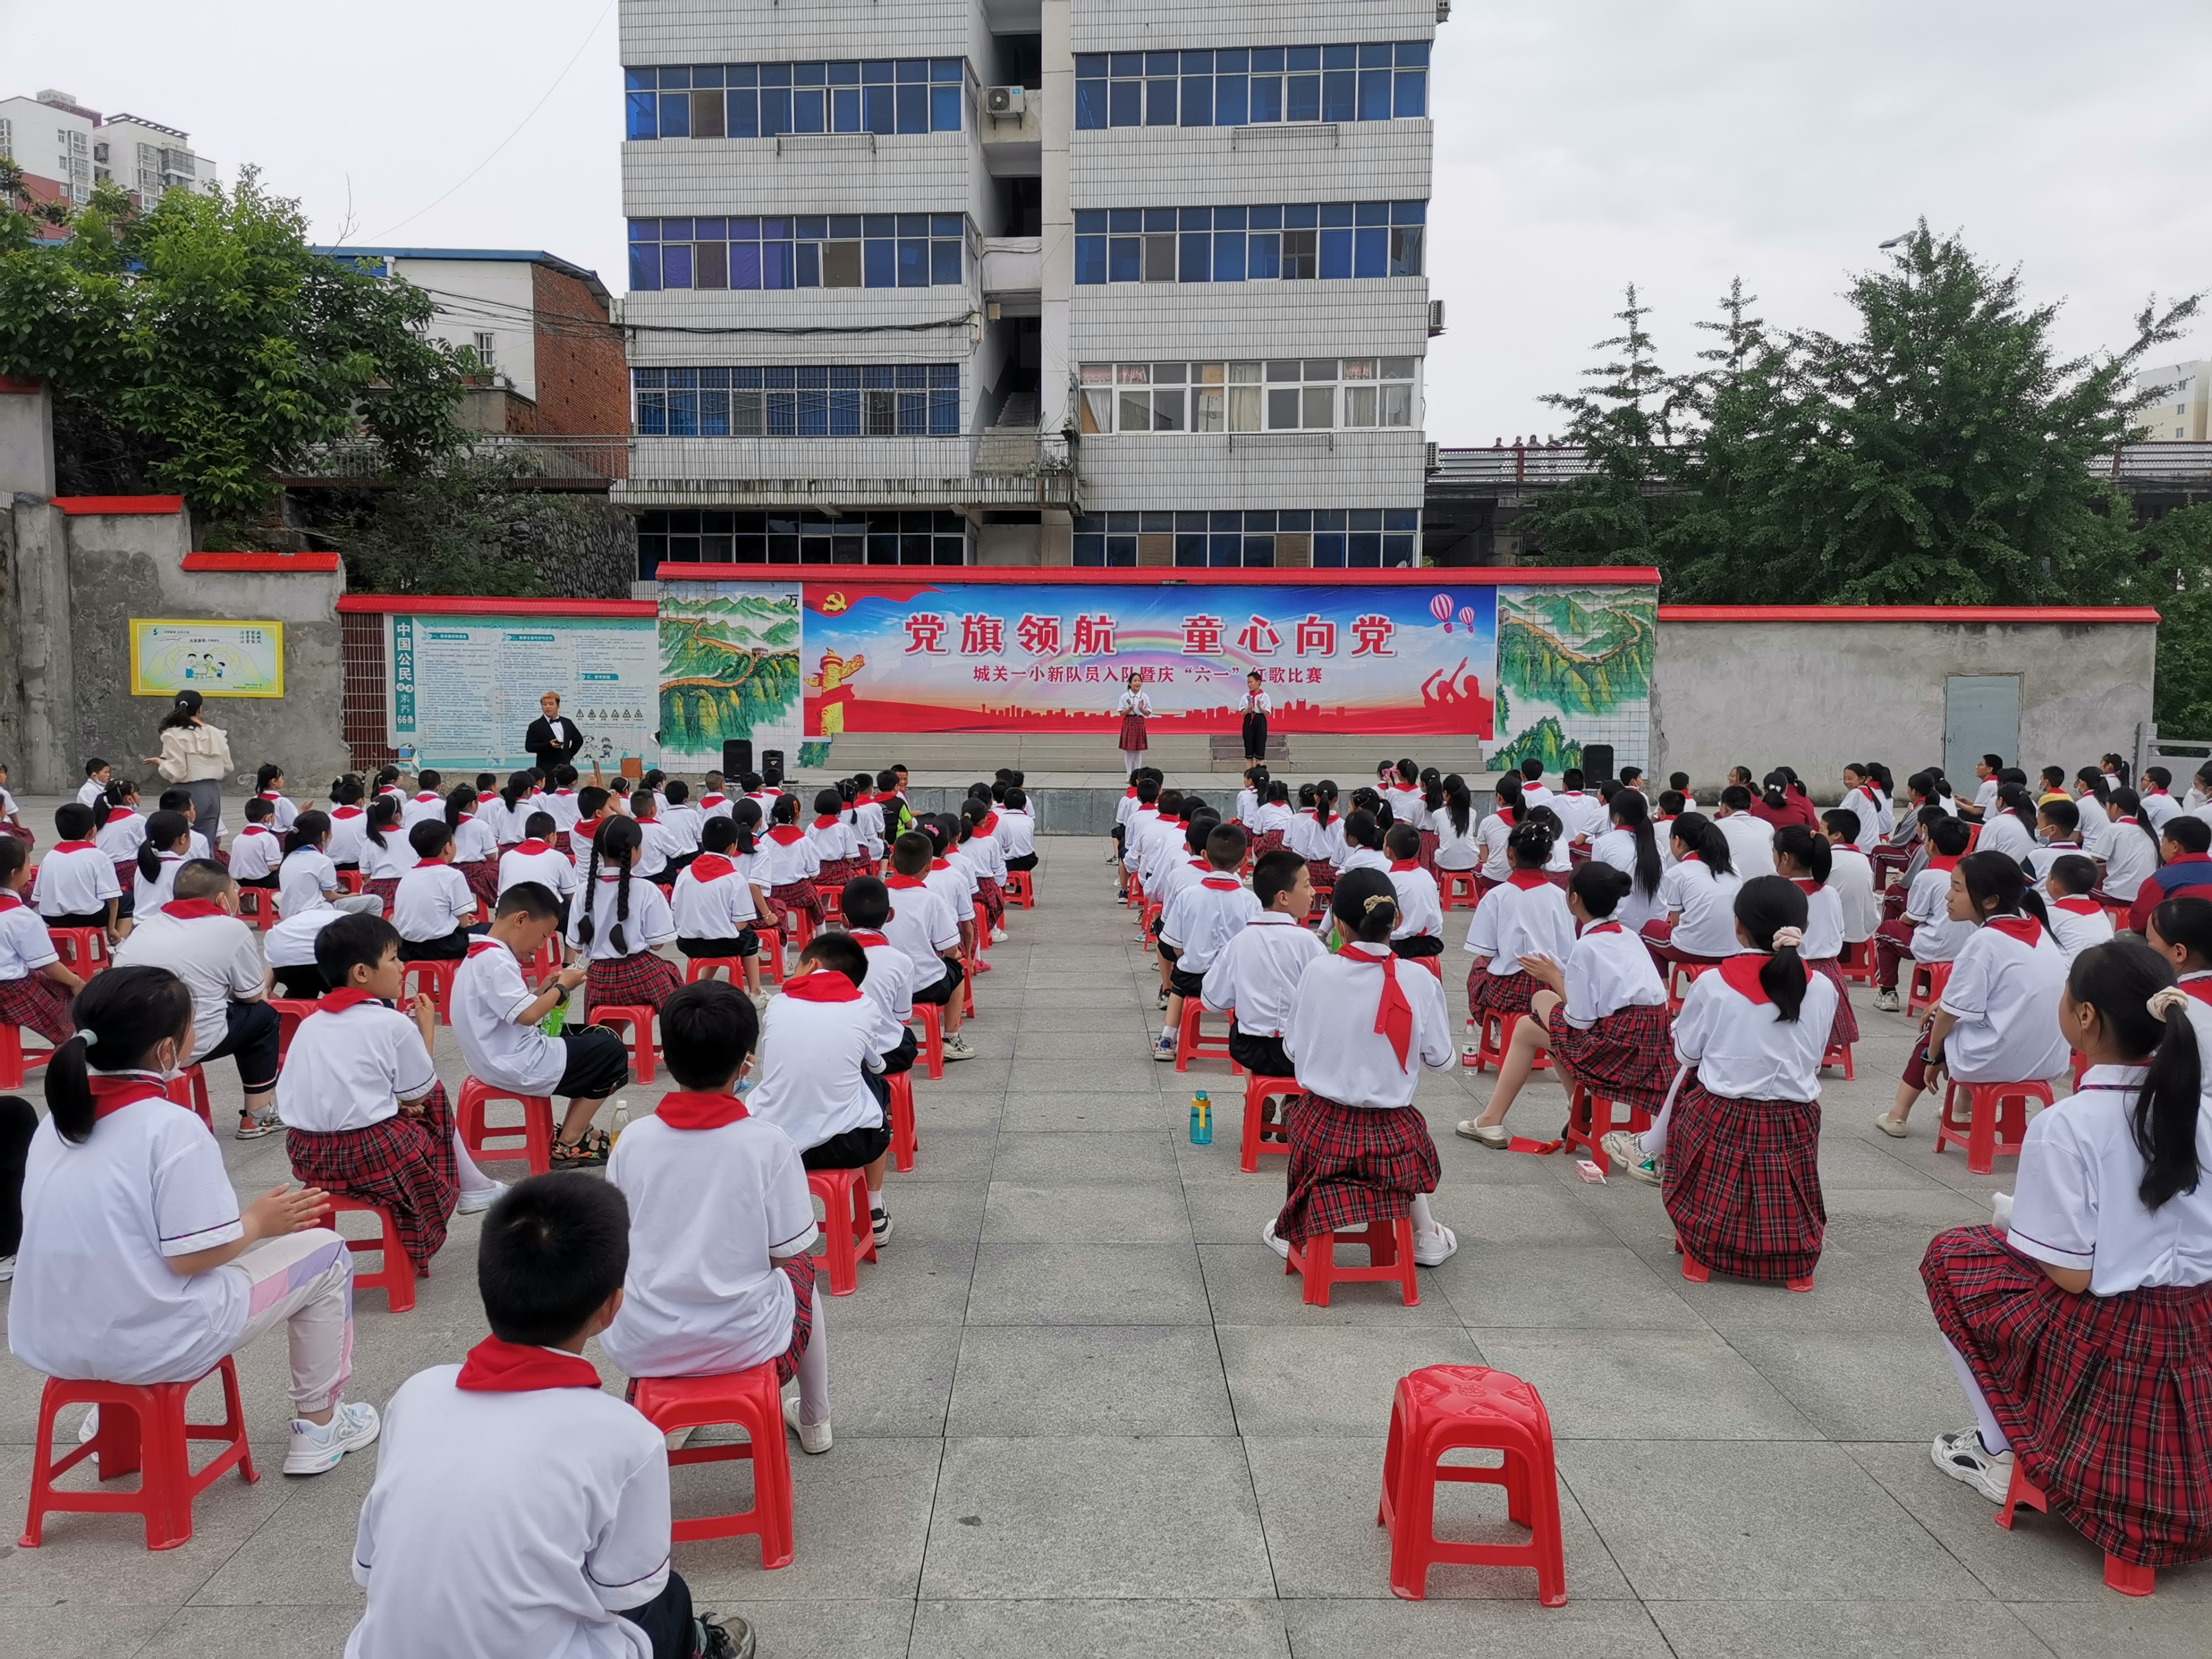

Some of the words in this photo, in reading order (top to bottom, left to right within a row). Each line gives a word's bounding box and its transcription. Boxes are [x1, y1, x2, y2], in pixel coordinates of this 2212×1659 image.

[904, 614, 1117, 654] 党旗领航
[1181, 615, 1393, 655] 童心向党
